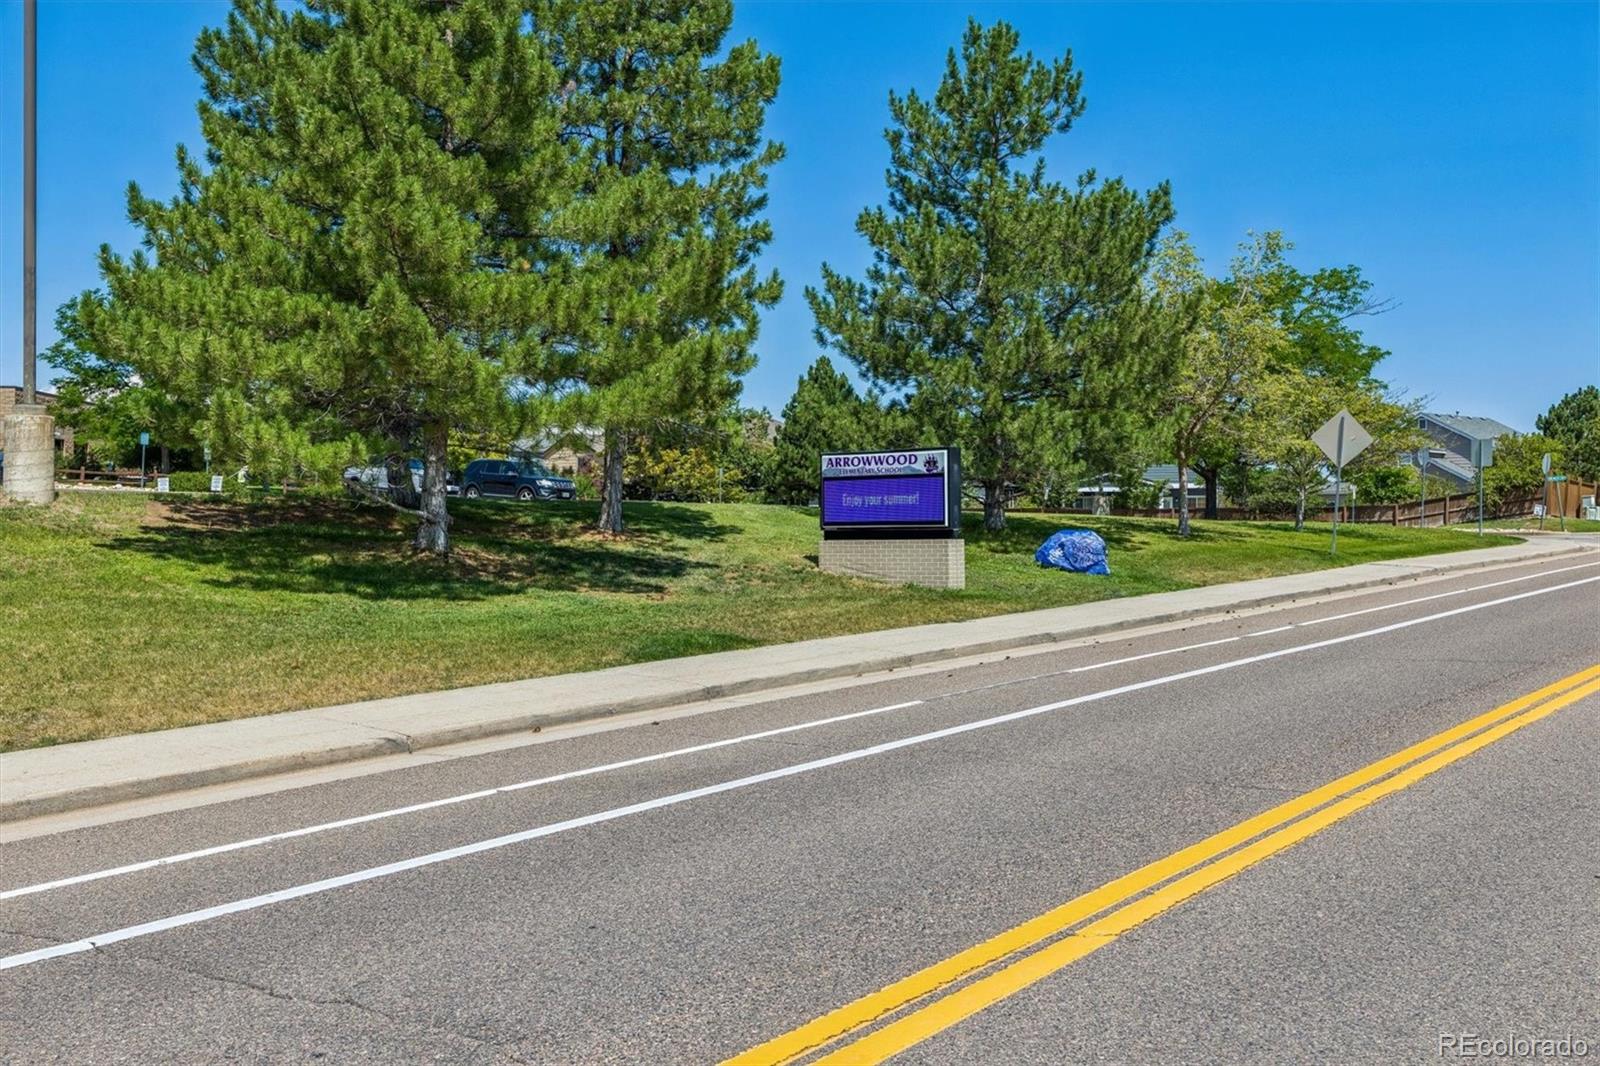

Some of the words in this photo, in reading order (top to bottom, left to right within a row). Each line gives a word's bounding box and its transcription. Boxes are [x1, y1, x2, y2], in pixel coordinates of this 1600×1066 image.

[825, 454, 918, 468] ARROWWOOD
[876, 466, 902, 474] SCHOOL
[842, 493, 862, 508] Enjoy
[864, 495, 882, 507] your
[883, 490, 919, 505] summer!
